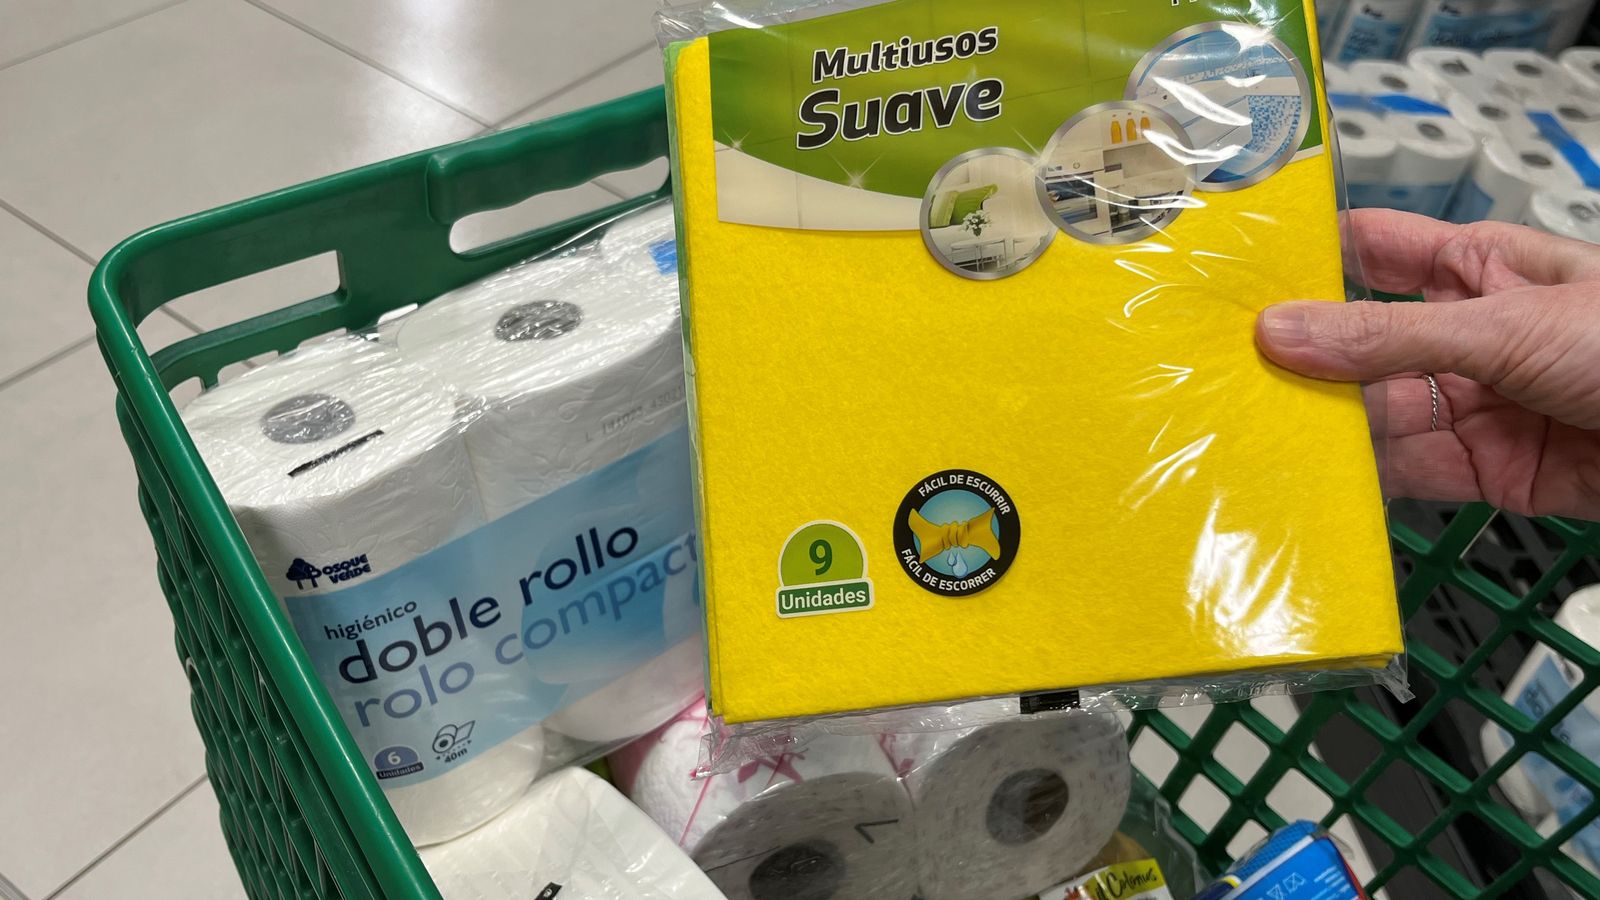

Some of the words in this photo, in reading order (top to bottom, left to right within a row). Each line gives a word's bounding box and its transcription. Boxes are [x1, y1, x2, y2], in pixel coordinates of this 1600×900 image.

[813, 27, 998, 83] Multiusos
[797, 78, 1003, 149] Suave
[918, 476, 948, 497] FÁCIL
[949, 474, 964, 485] DE
[966, 475, 1011, 515] ESCURRIR
[328, 564, 372, 584] VERDE
[808, 539, 833, 576] 9
[901, 548, 923, 578] FÁCIL
[922, 572, 938, 587] DE
[938, 568, 997, 591] ESCORRER
[338, 596, 502, 684] doble
[518, 526, 639, 606] rollo
[781, 587, 866, 610] Unidades
[324, 601, 417, 641] higiénico
[354, 661, 475, 727] rolo
[379, 763, 421, 778] Unidades
[388, 751, 402, 765] 6
[444, 747, 468, 763] 40m
